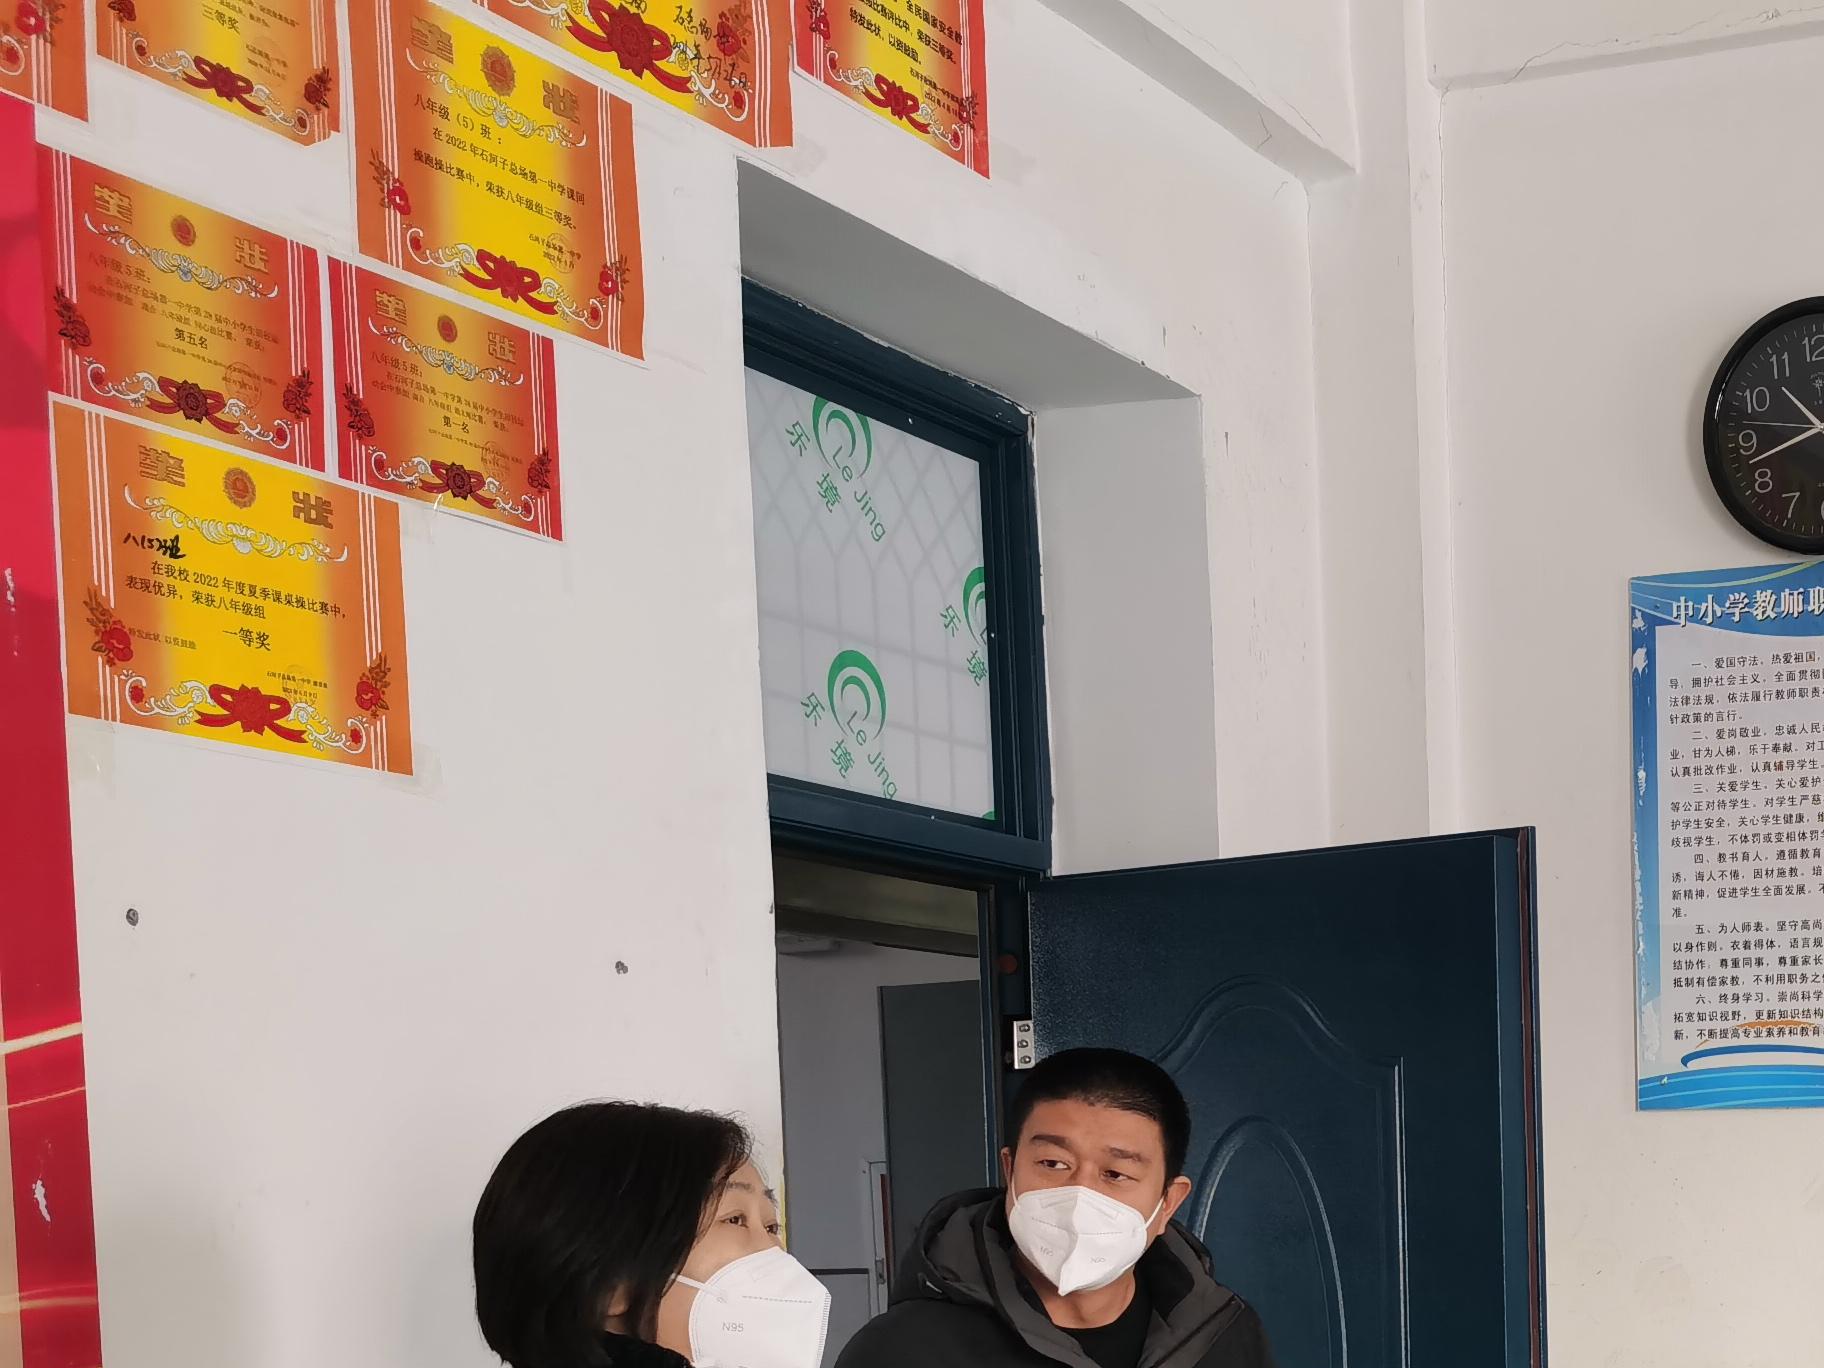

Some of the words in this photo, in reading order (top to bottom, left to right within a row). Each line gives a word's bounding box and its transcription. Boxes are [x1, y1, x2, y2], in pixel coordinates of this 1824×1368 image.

[174, 327, 209, 351] 第五名
[1769, 352, 1790, 380] 11
[1743, 386, 1770, 413] 10
[442, 414, 470, 434] 第一名
[1738, 429, 1757, 455] 9
[832, 445, 854, 482] Le
[854, 489, 887, 542] Jing
[1754, 468, 1773, 493] 8
[1781, 491, 1801, 518] 7
[222, 626, 272, 652] 一等奖
[847, 710, 868, 746] Le
[1669, 709, 1744, 725] 针政策的言行。
[721, 1321, 744, 1333] N95
